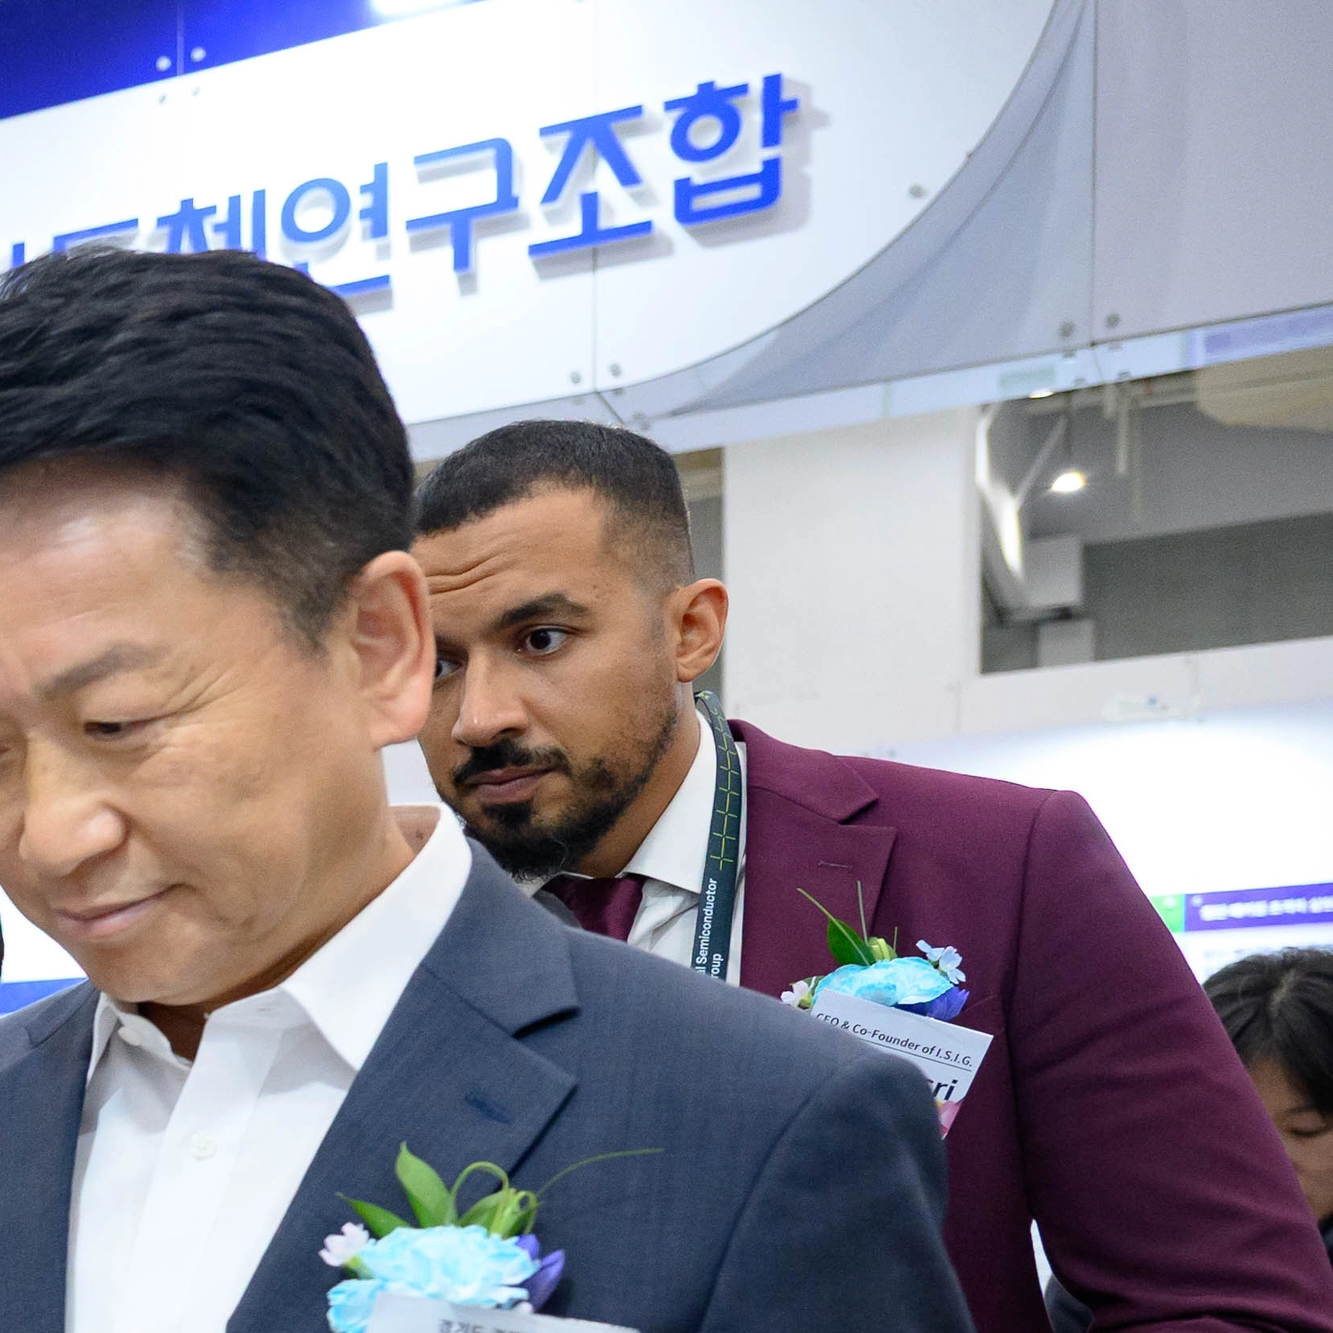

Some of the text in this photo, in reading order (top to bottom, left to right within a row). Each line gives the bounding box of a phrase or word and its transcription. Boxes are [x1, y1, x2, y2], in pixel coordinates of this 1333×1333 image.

[696, 878, 717, 964] Semiconductor
[711, 953, 724, 979] roup
[842, 1020, 851, 1030] &
[853, 1023, 921, 1052] Co-Founder
[922, 1045, 935, 1056] of
[935, 1048, 972, 1067] I.S.I.G.
[927, 1078, 958, 1101] ri
